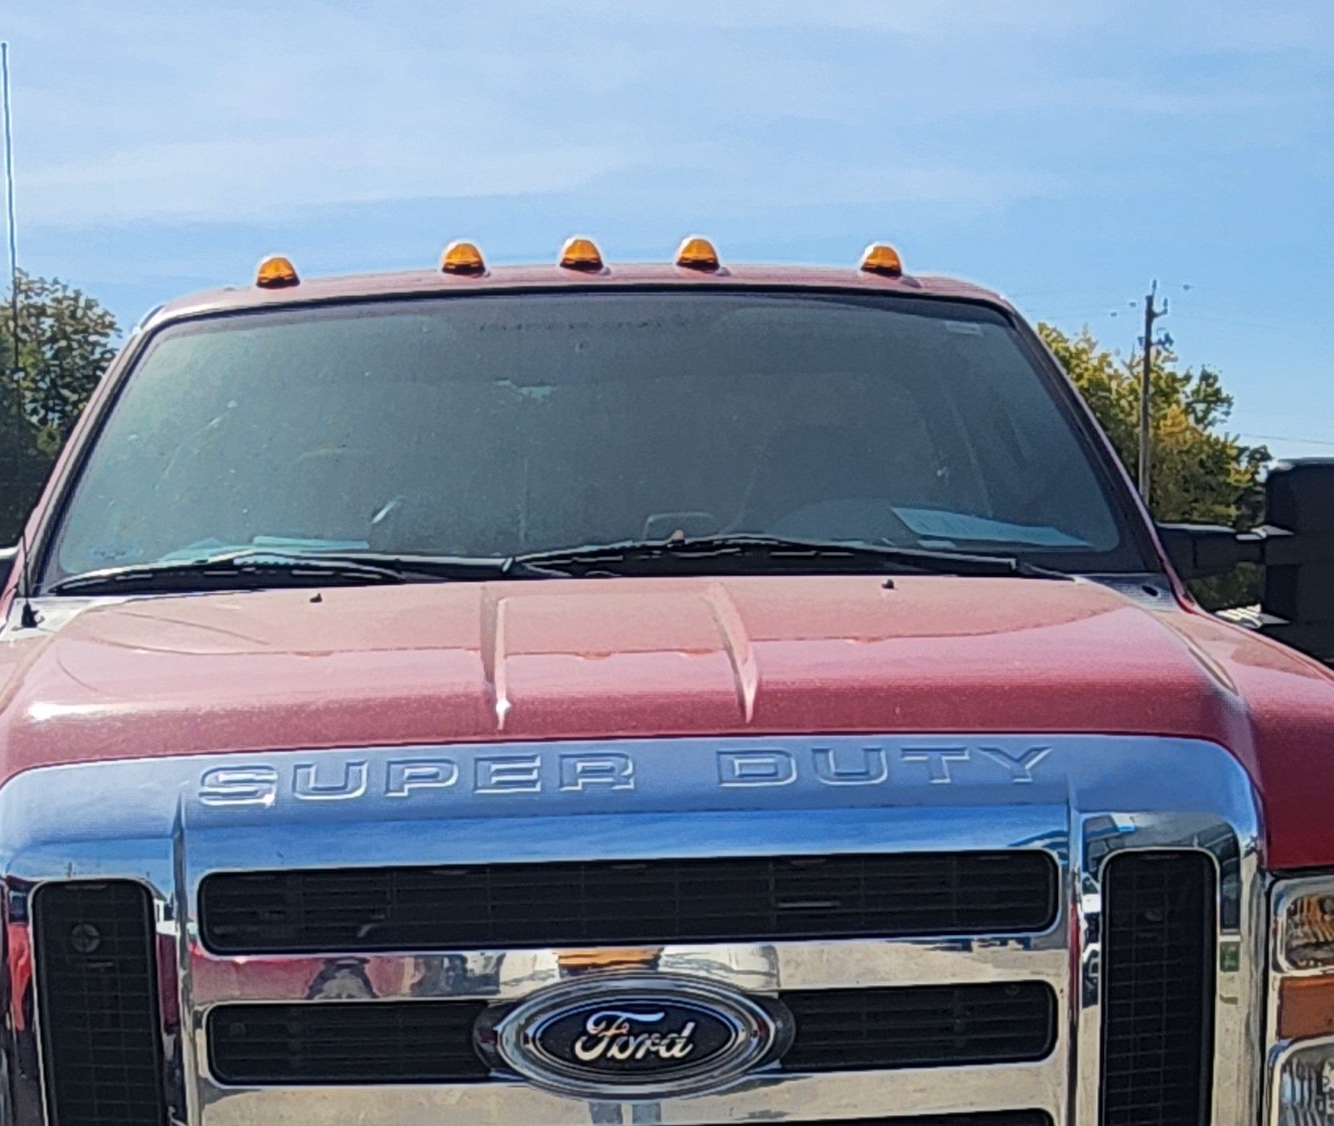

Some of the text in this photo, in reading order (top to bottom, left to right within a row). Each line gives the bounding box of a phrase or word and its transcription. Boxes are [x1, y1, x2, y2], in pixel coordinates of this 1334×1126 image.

[198, 746, 1053, 807] SUPER DUTY
[574, 1010, 696, 1060] Ford
